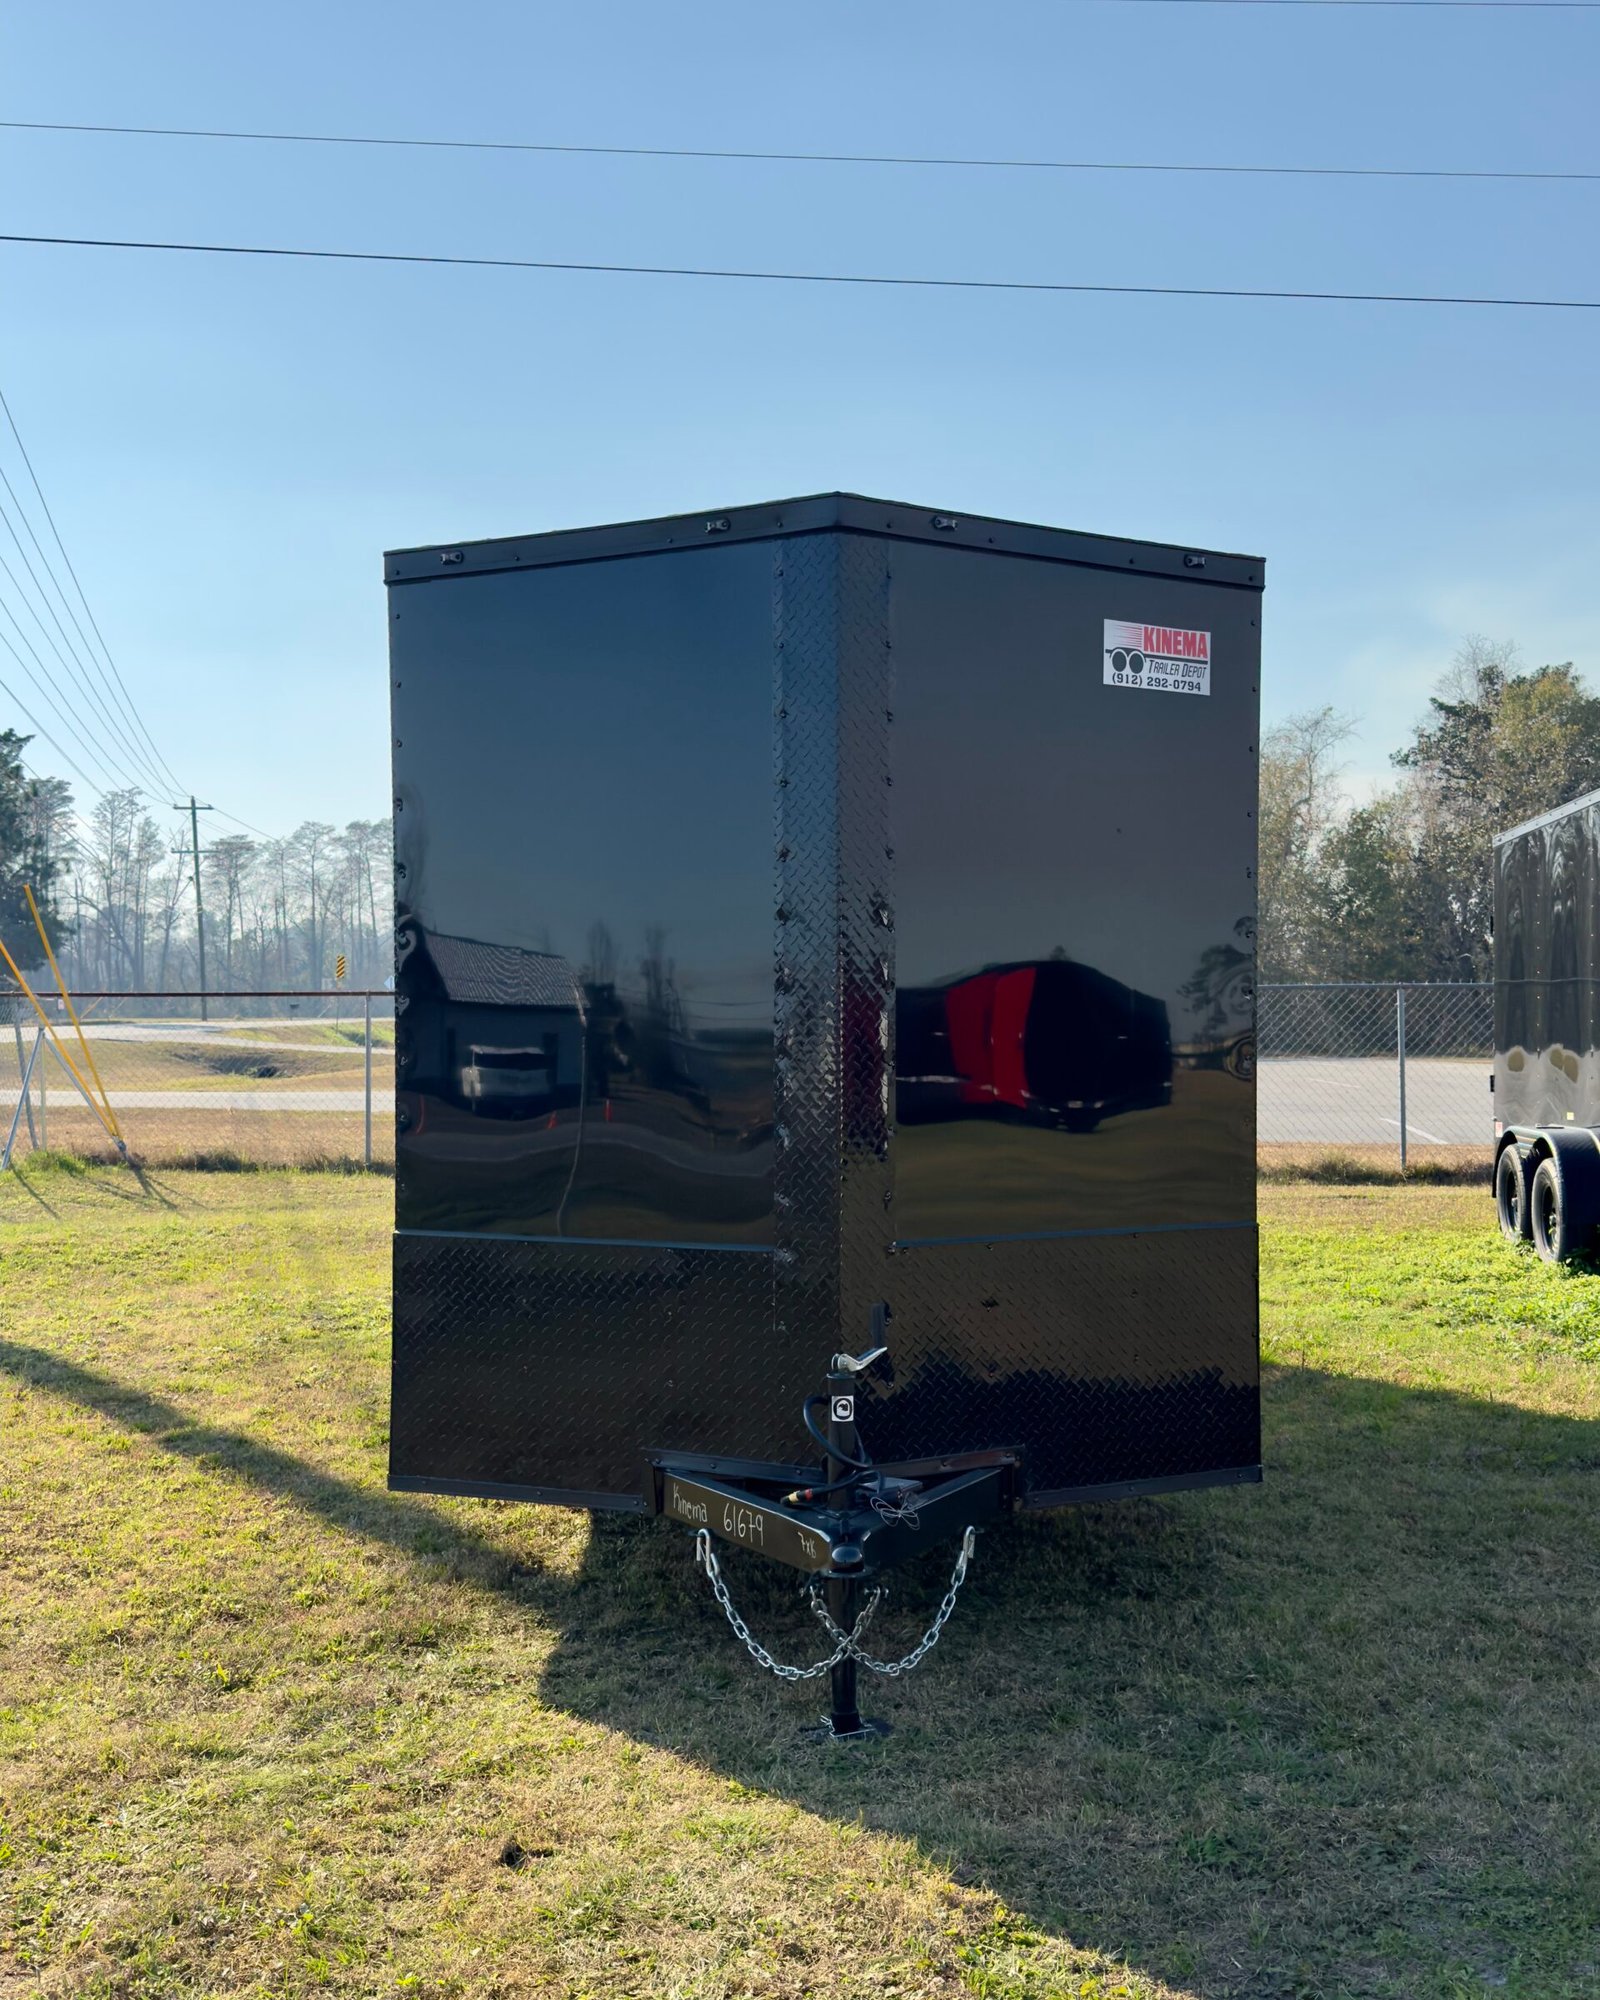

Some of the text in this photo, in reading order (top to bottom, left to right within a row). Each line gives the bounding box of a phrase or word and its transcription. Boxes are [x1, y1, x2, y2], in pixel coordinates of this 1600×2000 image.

[1144, 626, 1208, 659] KINEMA
[1112, 672, 1201, 692] (912) 292-0794
[1149, 659, 1207, 679] TRAILER DEPOT
[723, 1502, 764, 1546] 61679
